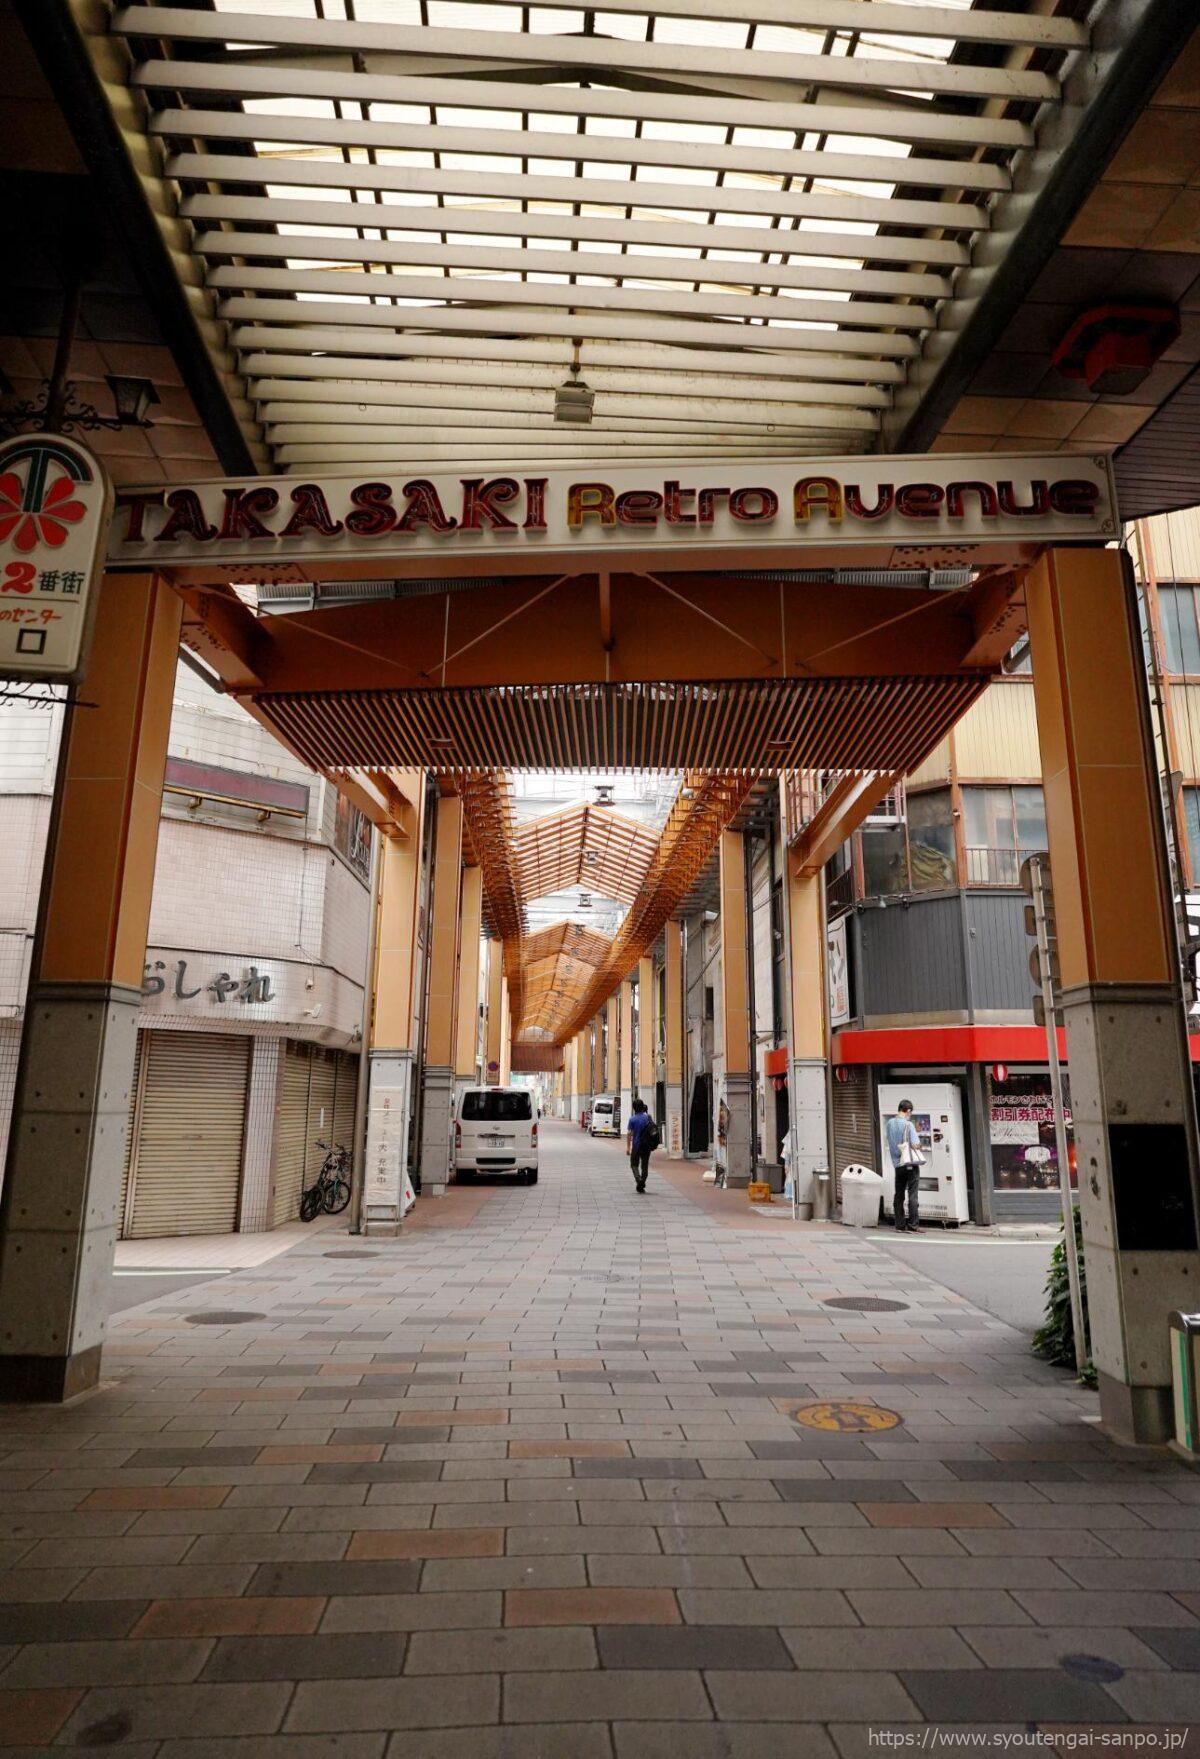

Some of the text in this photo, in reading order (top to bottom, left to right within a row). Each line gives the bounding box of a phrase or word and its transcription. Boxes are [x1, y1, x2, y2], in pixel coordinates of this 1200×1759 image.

[115, 475, 1100, 542] TAKASAKI Retro Avenue
[0, 561, 85, 594] 2番街
